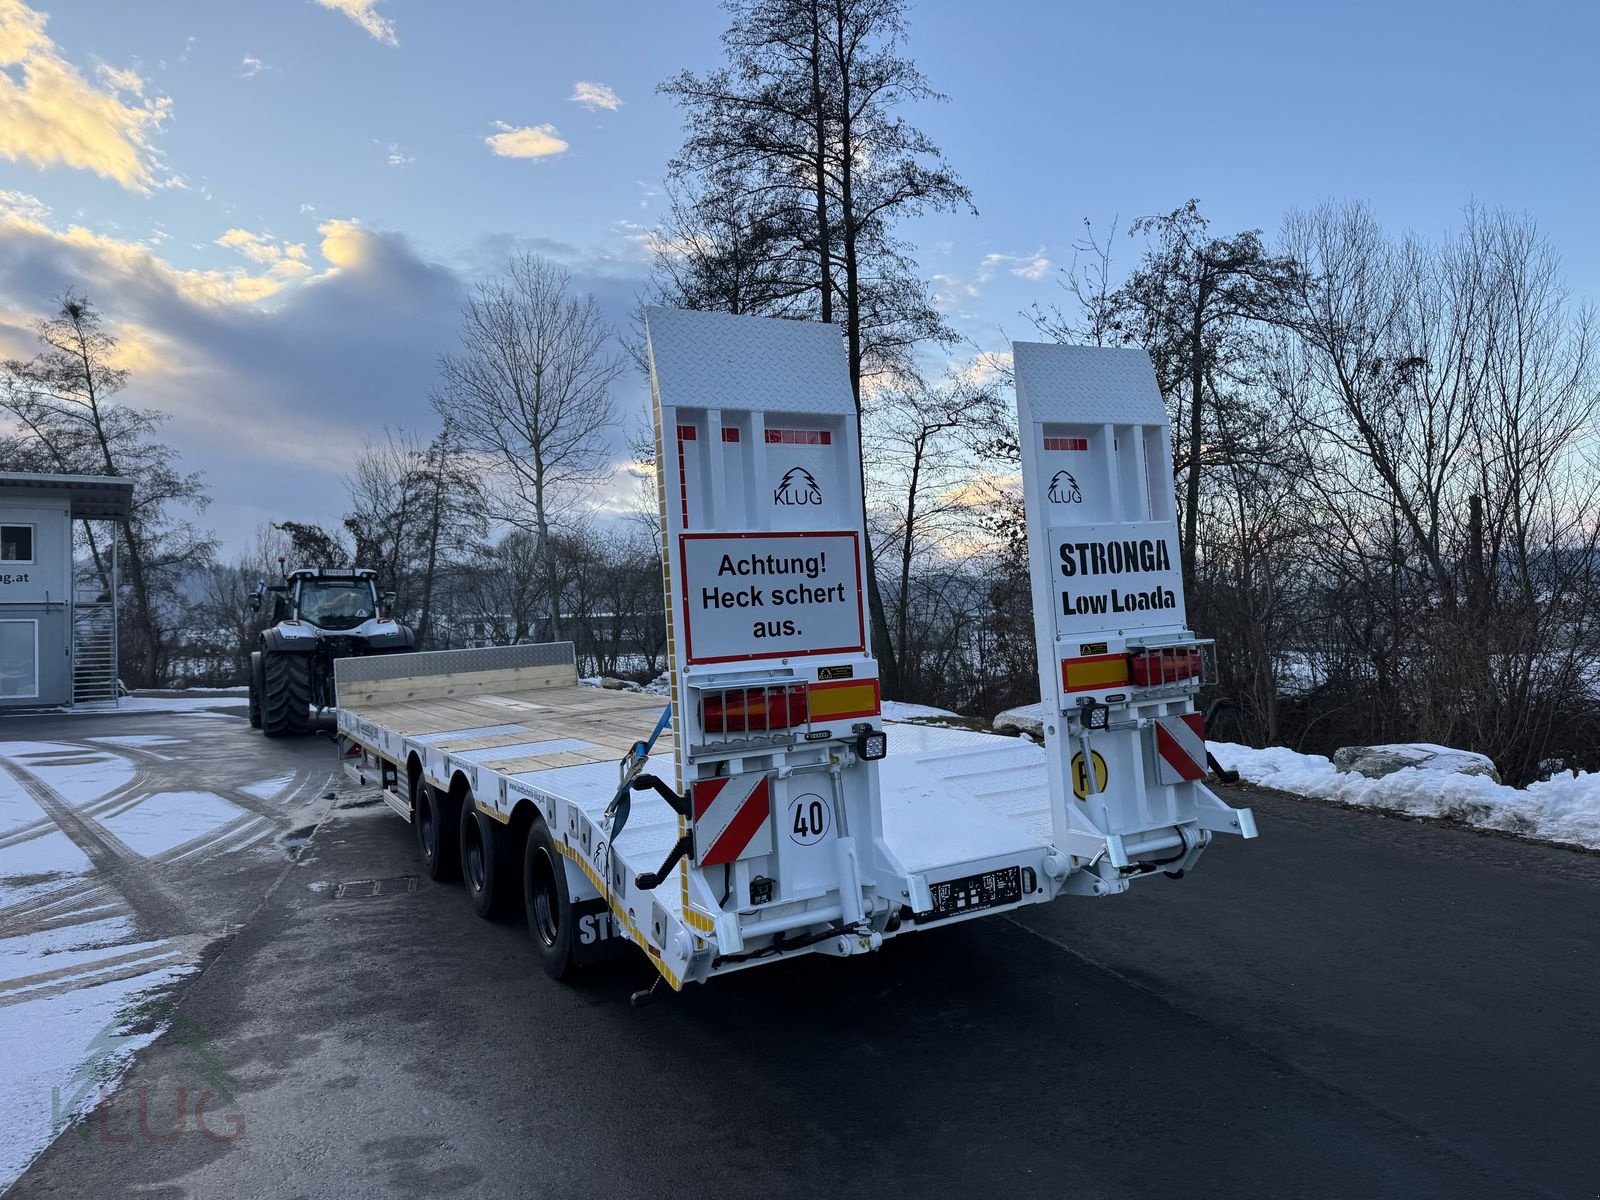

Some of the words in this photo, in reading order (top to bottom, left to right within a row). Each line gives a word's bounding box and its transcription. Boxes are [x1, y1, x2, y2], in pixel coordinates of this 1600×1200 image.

[774, 489, 822, 505] KLUG
[718, 552, 826, 578] Achtung!
[1060, 540, 1170, 576] STRONGA
[702, 585, 764, 609] Heck
[771, 583, 845, 606] schert
[1062, 591, 1107, 615] Low
[1111, 586, 1176, 612] Loada
[753, 619, 802, 638] aus.
[794, 801, 823, 837] 40
